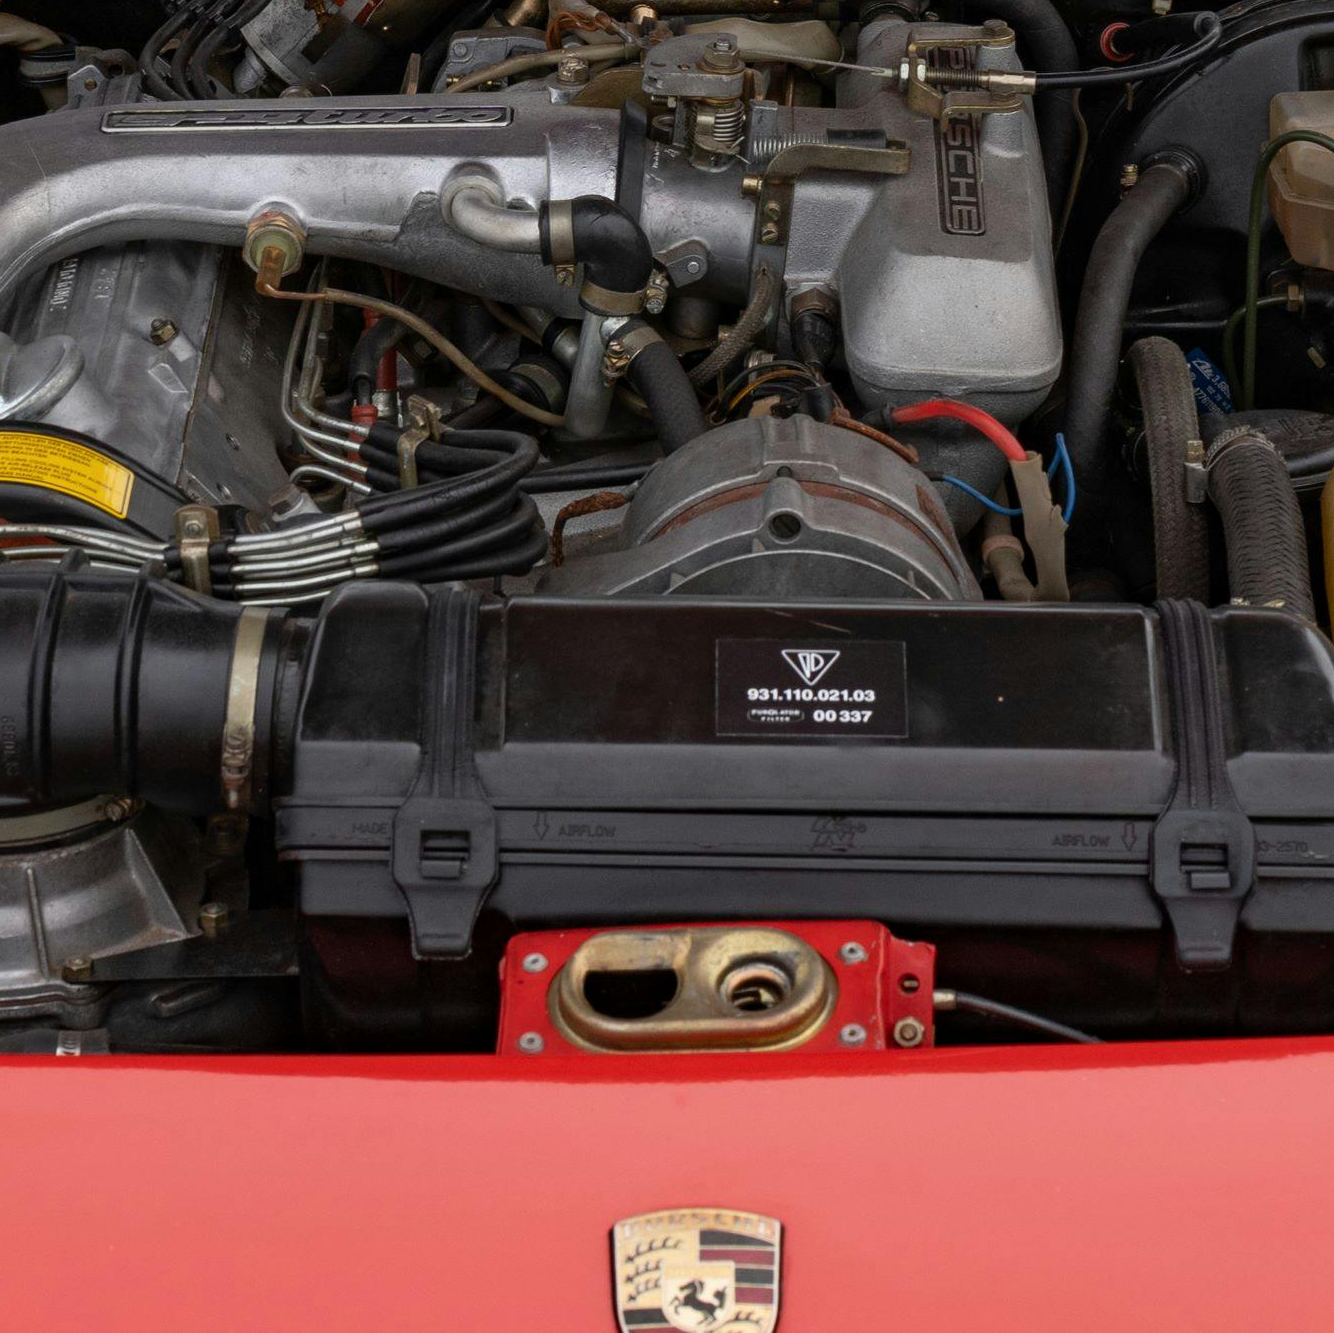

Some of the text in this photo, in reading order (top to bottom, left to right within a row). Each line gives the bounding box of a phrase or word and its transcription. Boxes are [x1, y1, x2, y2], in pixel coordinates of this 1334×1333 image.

[305, 107, 504, 126] turbo
[938, 47, 978, 230] PSCHE
[747, 688, 875, 703] 931.110.021.03
[813, 710, 873, 723] 00 337
[558, 825, 616, 838] AIRFLOW
[1052, 834, 1110, 848] AIRFLOW
